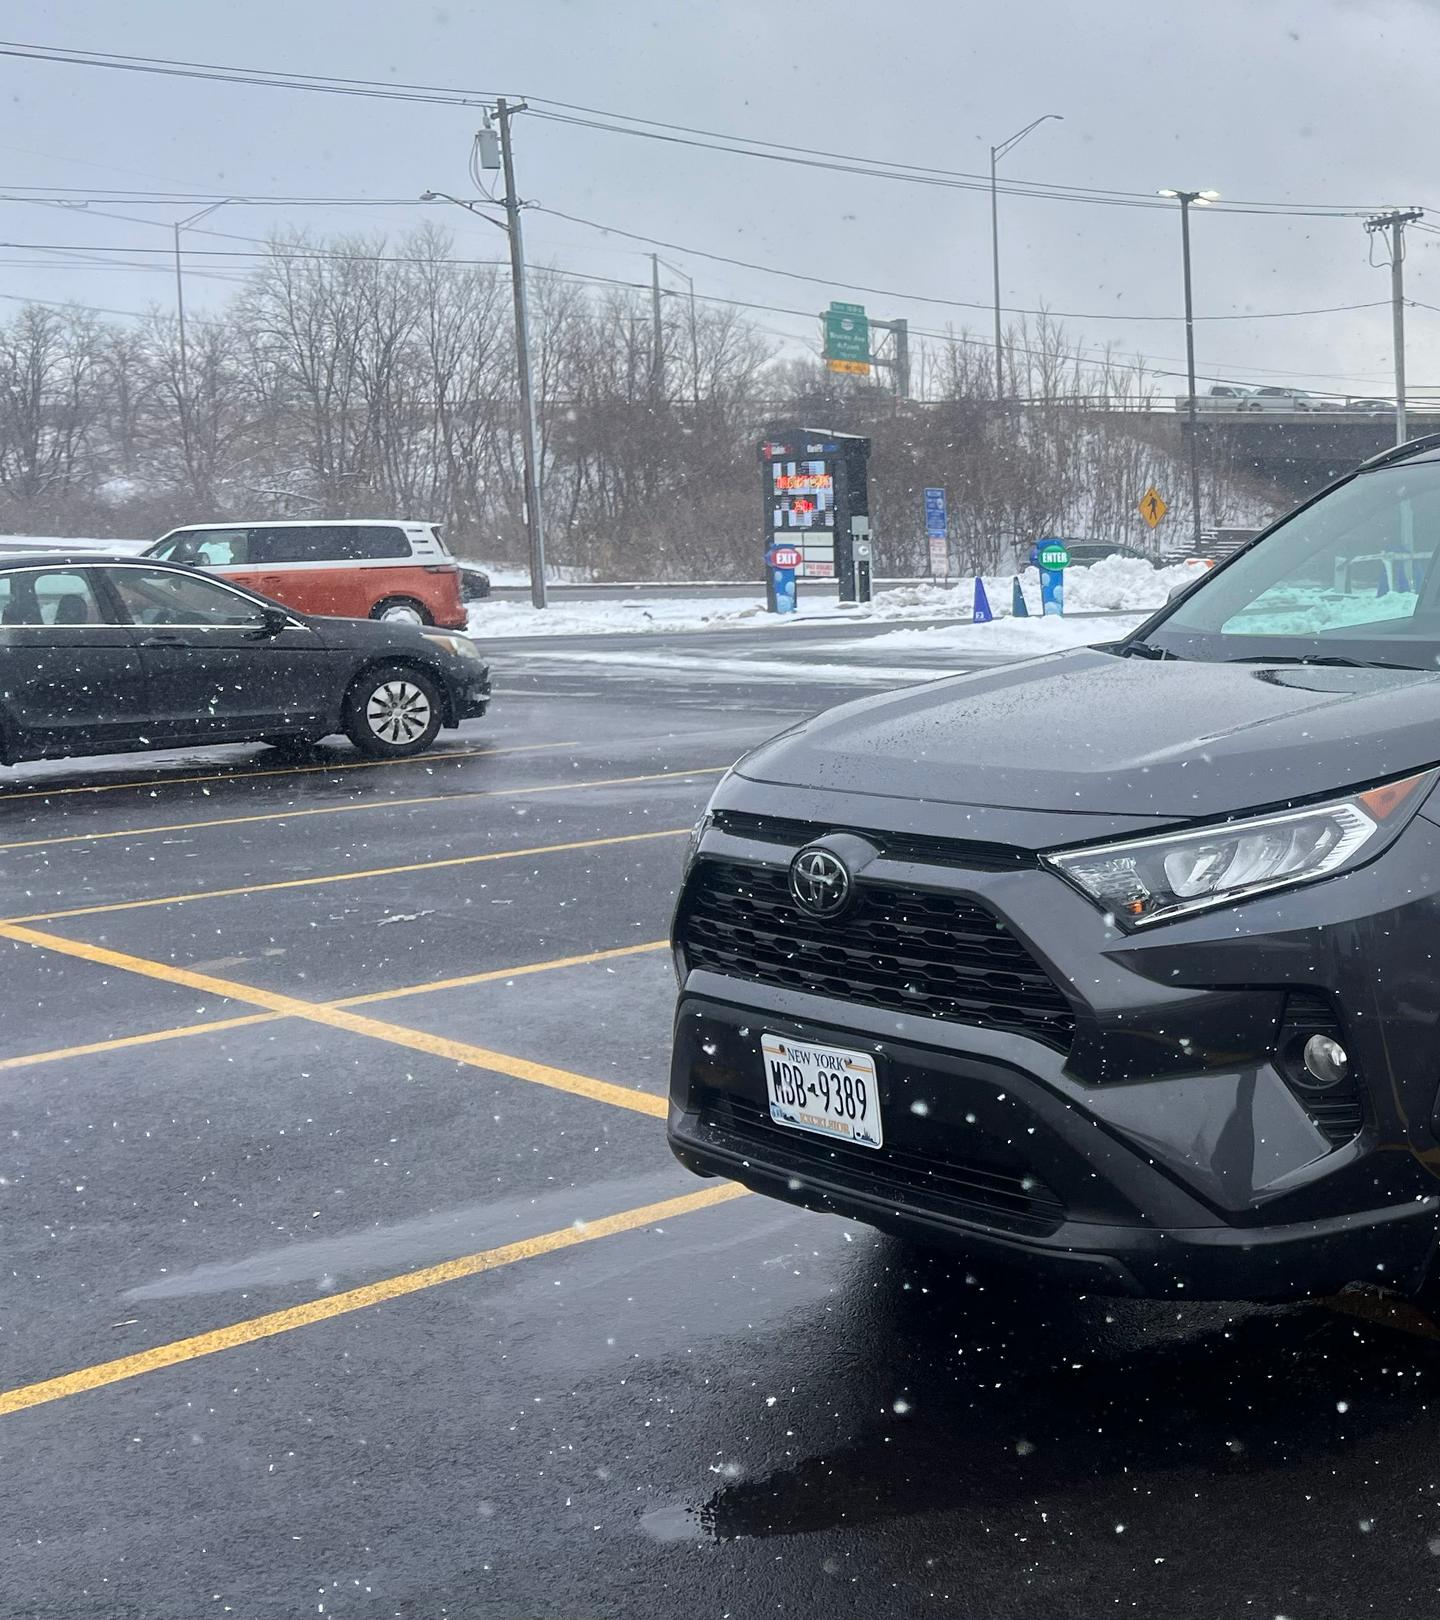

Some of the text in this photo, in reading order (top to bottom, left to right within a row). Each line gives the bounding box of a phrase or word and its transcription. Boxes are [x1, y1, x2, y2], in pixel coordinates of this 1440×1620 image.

[776, 552, 797, 564] EXIT
[1042, 552, 1068, 563] ENTER
[787, 1047, 846, 1072] NEW YORK
